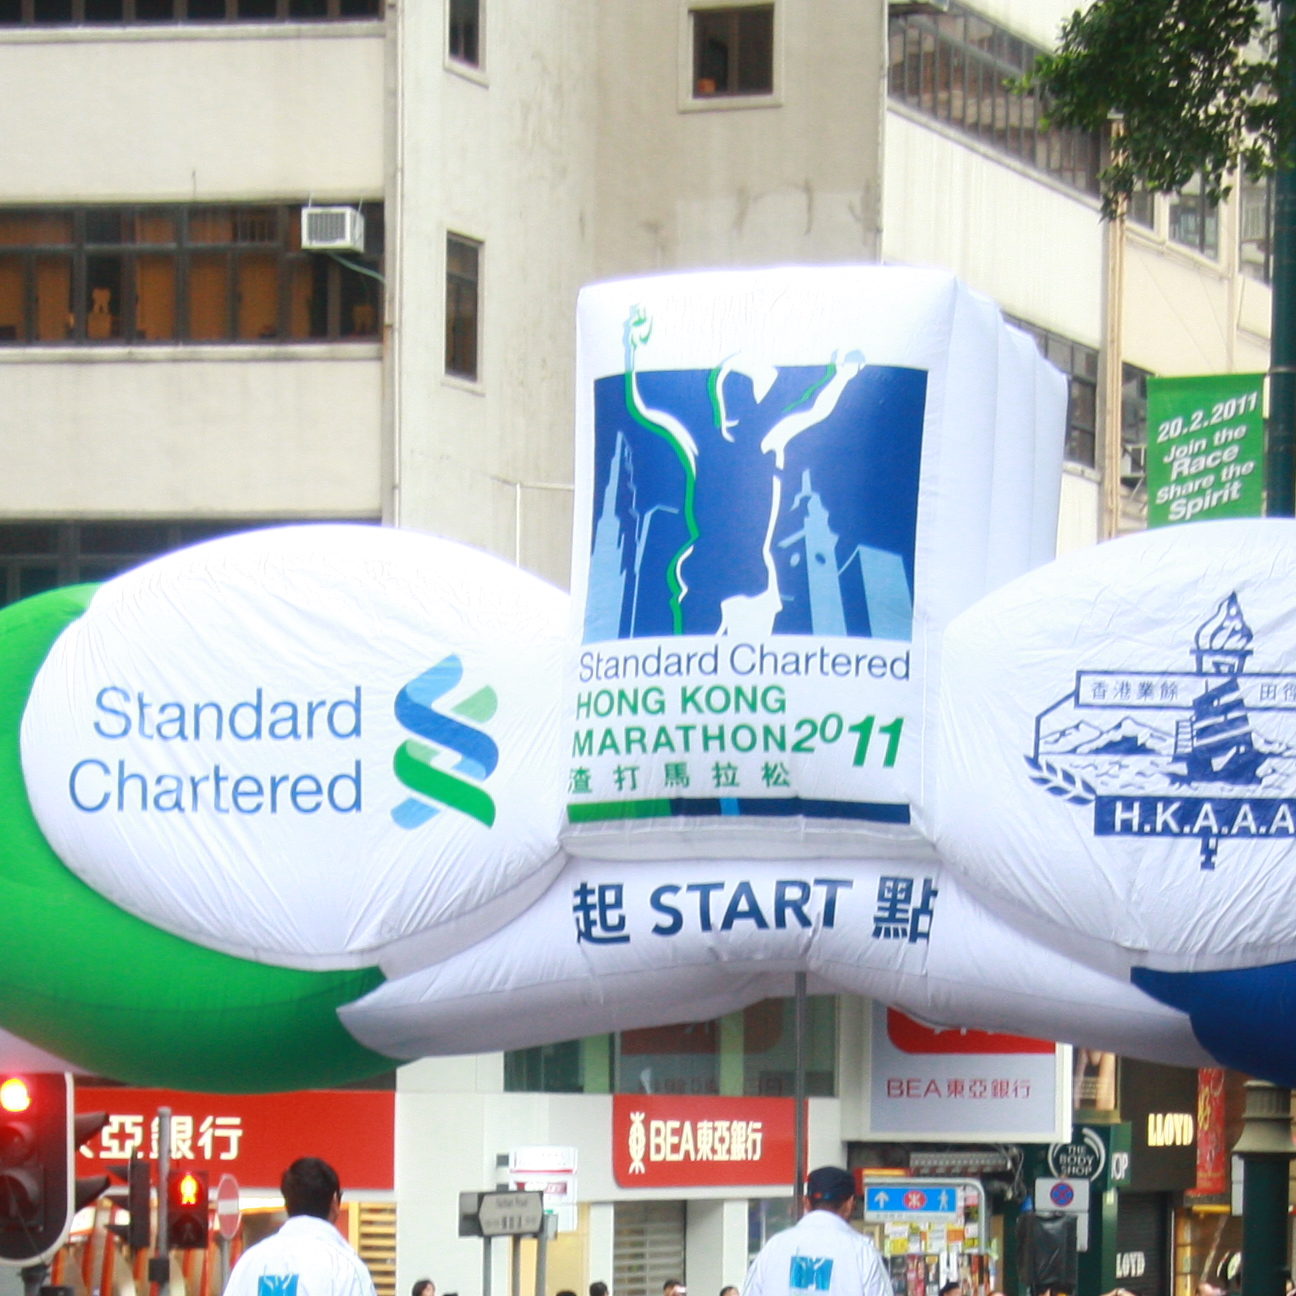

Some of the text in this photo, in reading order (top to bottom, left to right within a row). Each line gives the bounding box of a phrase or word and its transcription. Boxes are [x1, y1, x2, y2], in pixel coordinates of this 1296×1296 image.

[1156, 391, 1258, 443] 20.2.2011
[1163, 425, 1247, 464] Join the
[1170, 445, 1240, 481] Race
[1155, 460, 1255, 505] Share the
[1167, 481, 1242, 522] Spirit
[579, 644, 911, 683] Standard Chartered
[92, 685, 363, 743] Standard
[575, 685, 786, 721] HONG KONG
[572, 713, 905, 768] MARATHON 2011
[68, 758, 363, 815] Chartered
[568, 762, 791, 794] 渣打馬拉松
[572, 881, 631, 945] 起
[649, 878, 854, 936] START
[886, 1078, 942, 1099] BEA
[946, 1078, 1032, 1099] 東亞銀行
[78, 1114, 244, 1161] 亞銀行
[649, 1119, 695, 1162] BEA
[697, 1119, 763, 1162] 東亞銀行
[1147, 1112, 1195, 1147] LLOYD
[1058, 1154, 1095, 1167] BODY
[1067, 1145, 1087, 1155] THE
[1061, 1164, 1093, 1177] SHOP
[1115, 1251, 1146, 1279] LOYD
